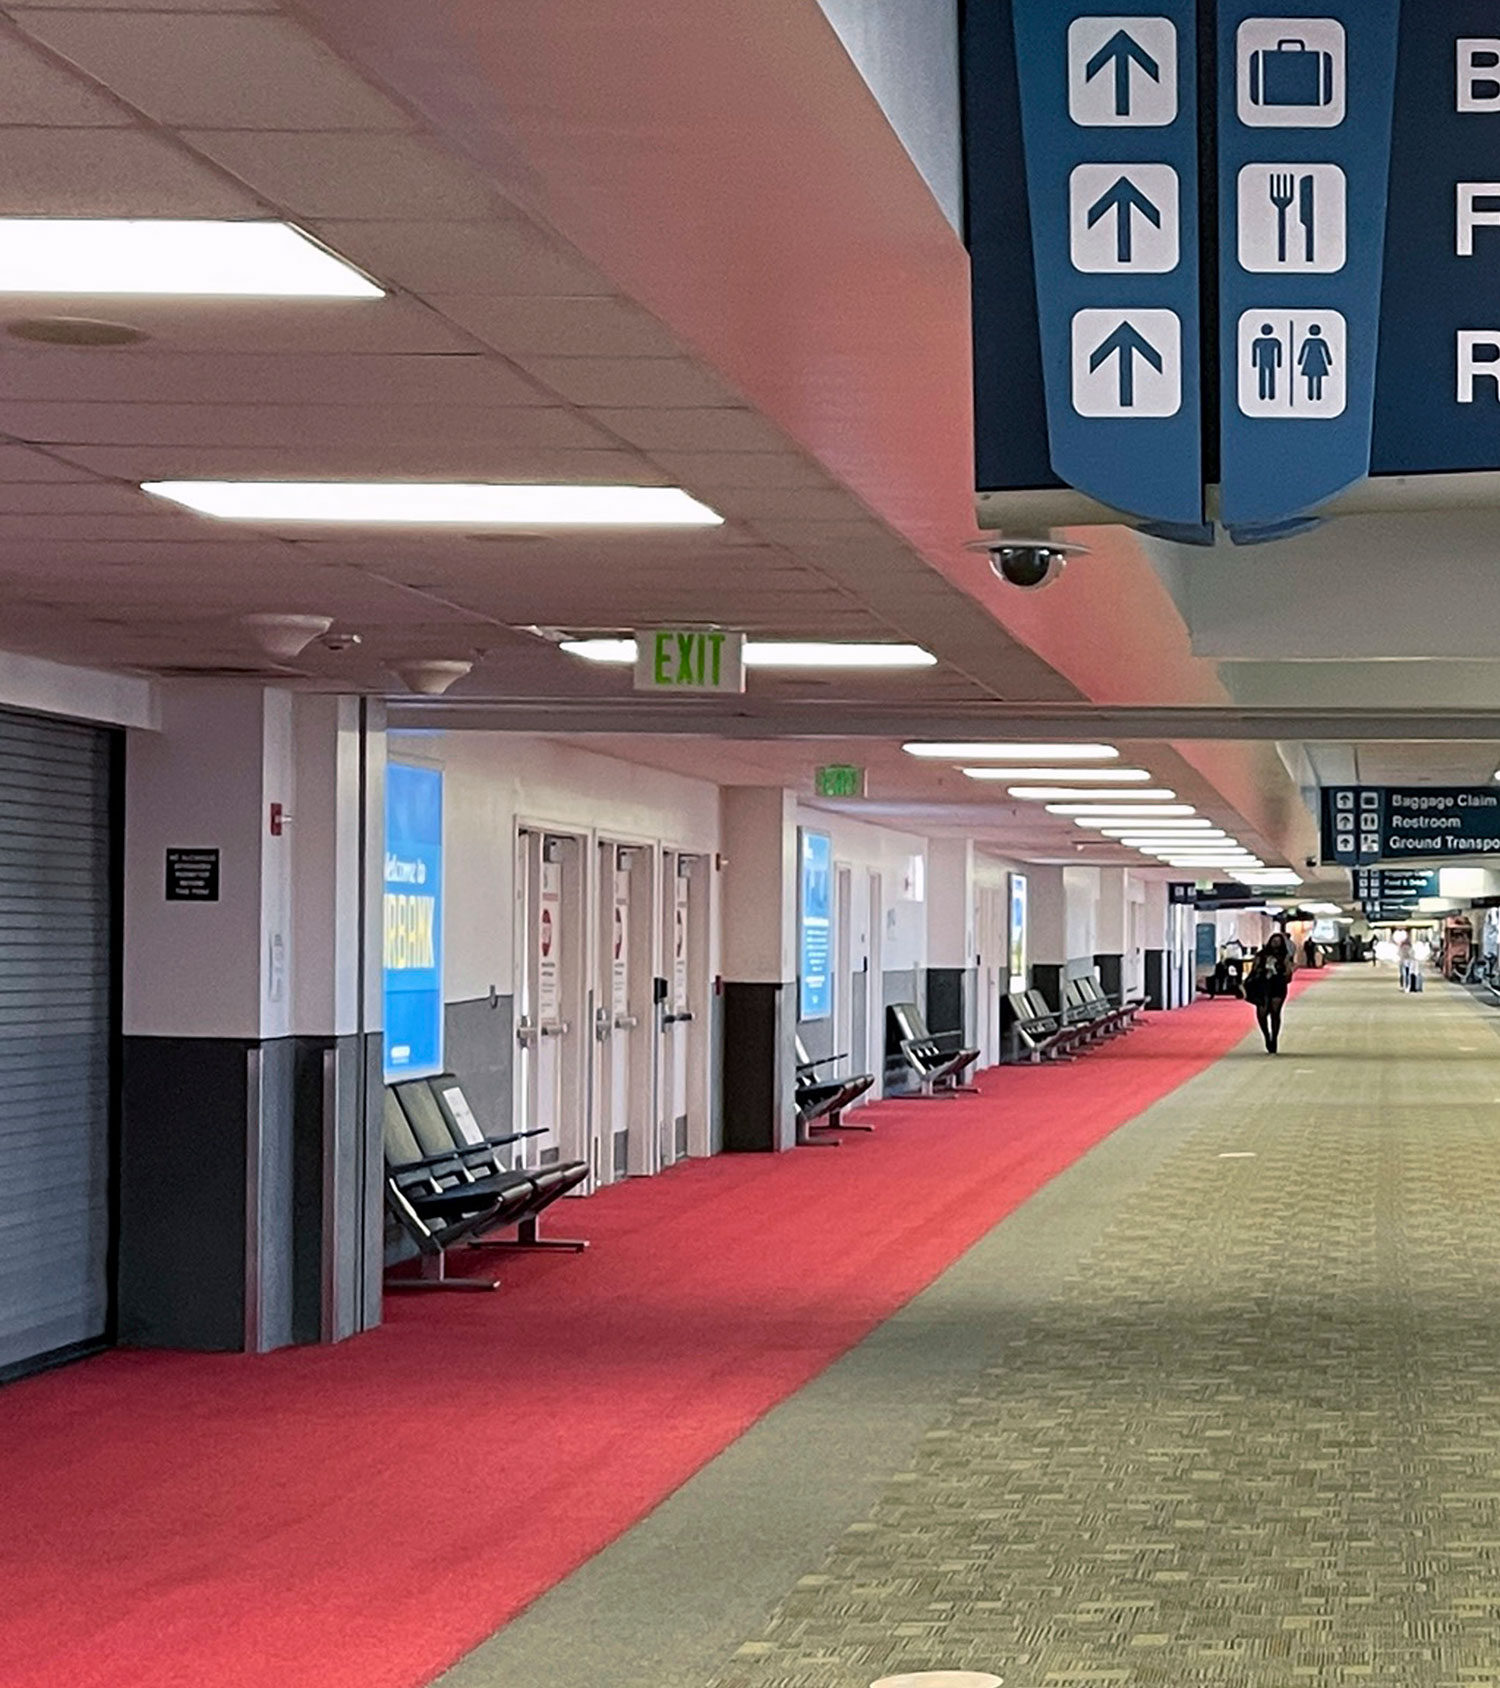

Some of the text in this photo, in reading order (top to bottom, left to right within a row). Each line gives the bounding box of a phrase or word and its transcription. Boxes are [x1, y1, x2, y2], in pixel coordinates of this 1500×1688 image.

[655, 632, 726, 686] EXIT
[1391, 794, 1498, 810] Baggage Claim
[1391, 815, 1461, 829] Restroom
[1389, 835, 1442, 850] Ground
